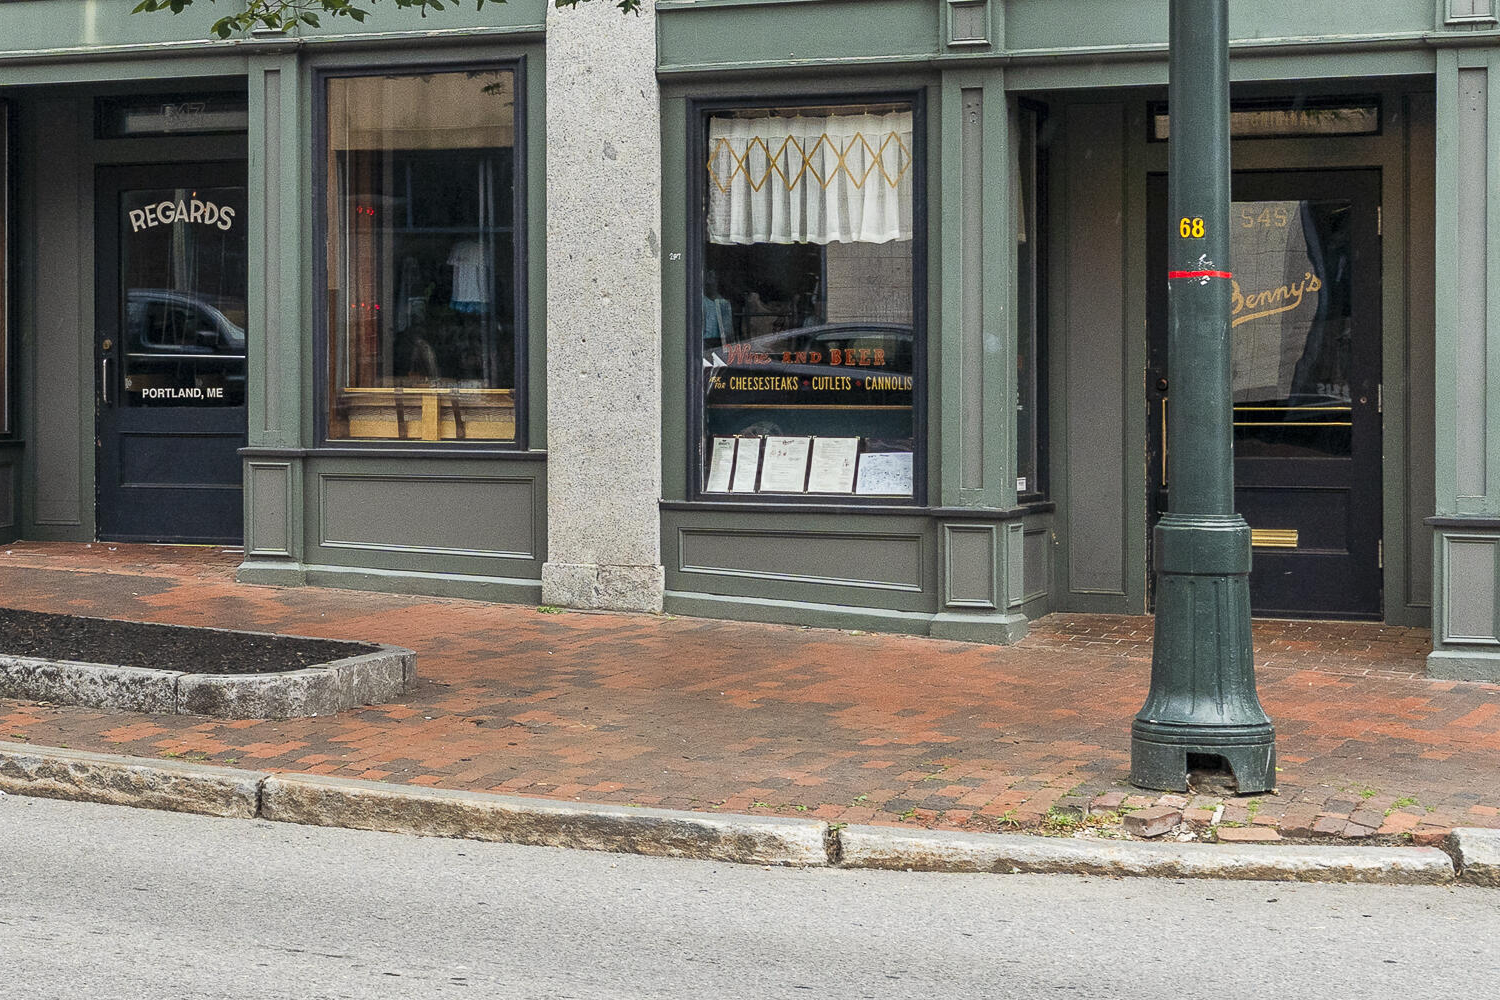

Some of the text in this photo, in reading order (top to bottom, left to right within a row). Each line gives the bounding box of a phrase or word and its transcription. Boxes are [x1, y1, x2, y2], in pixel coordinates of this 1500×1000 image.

[129, 199, 236, 232] REGARDS
[1179, 217, 1205, 238] 68
[782, 351, 822, 364] AND
[829, 348, 886, 367] BEER
[729, 376, 913, 391] CHEESESTEAKS CUTLETS CANNOLIS
[142, 387, 223, 400] PORTLAND, ME
